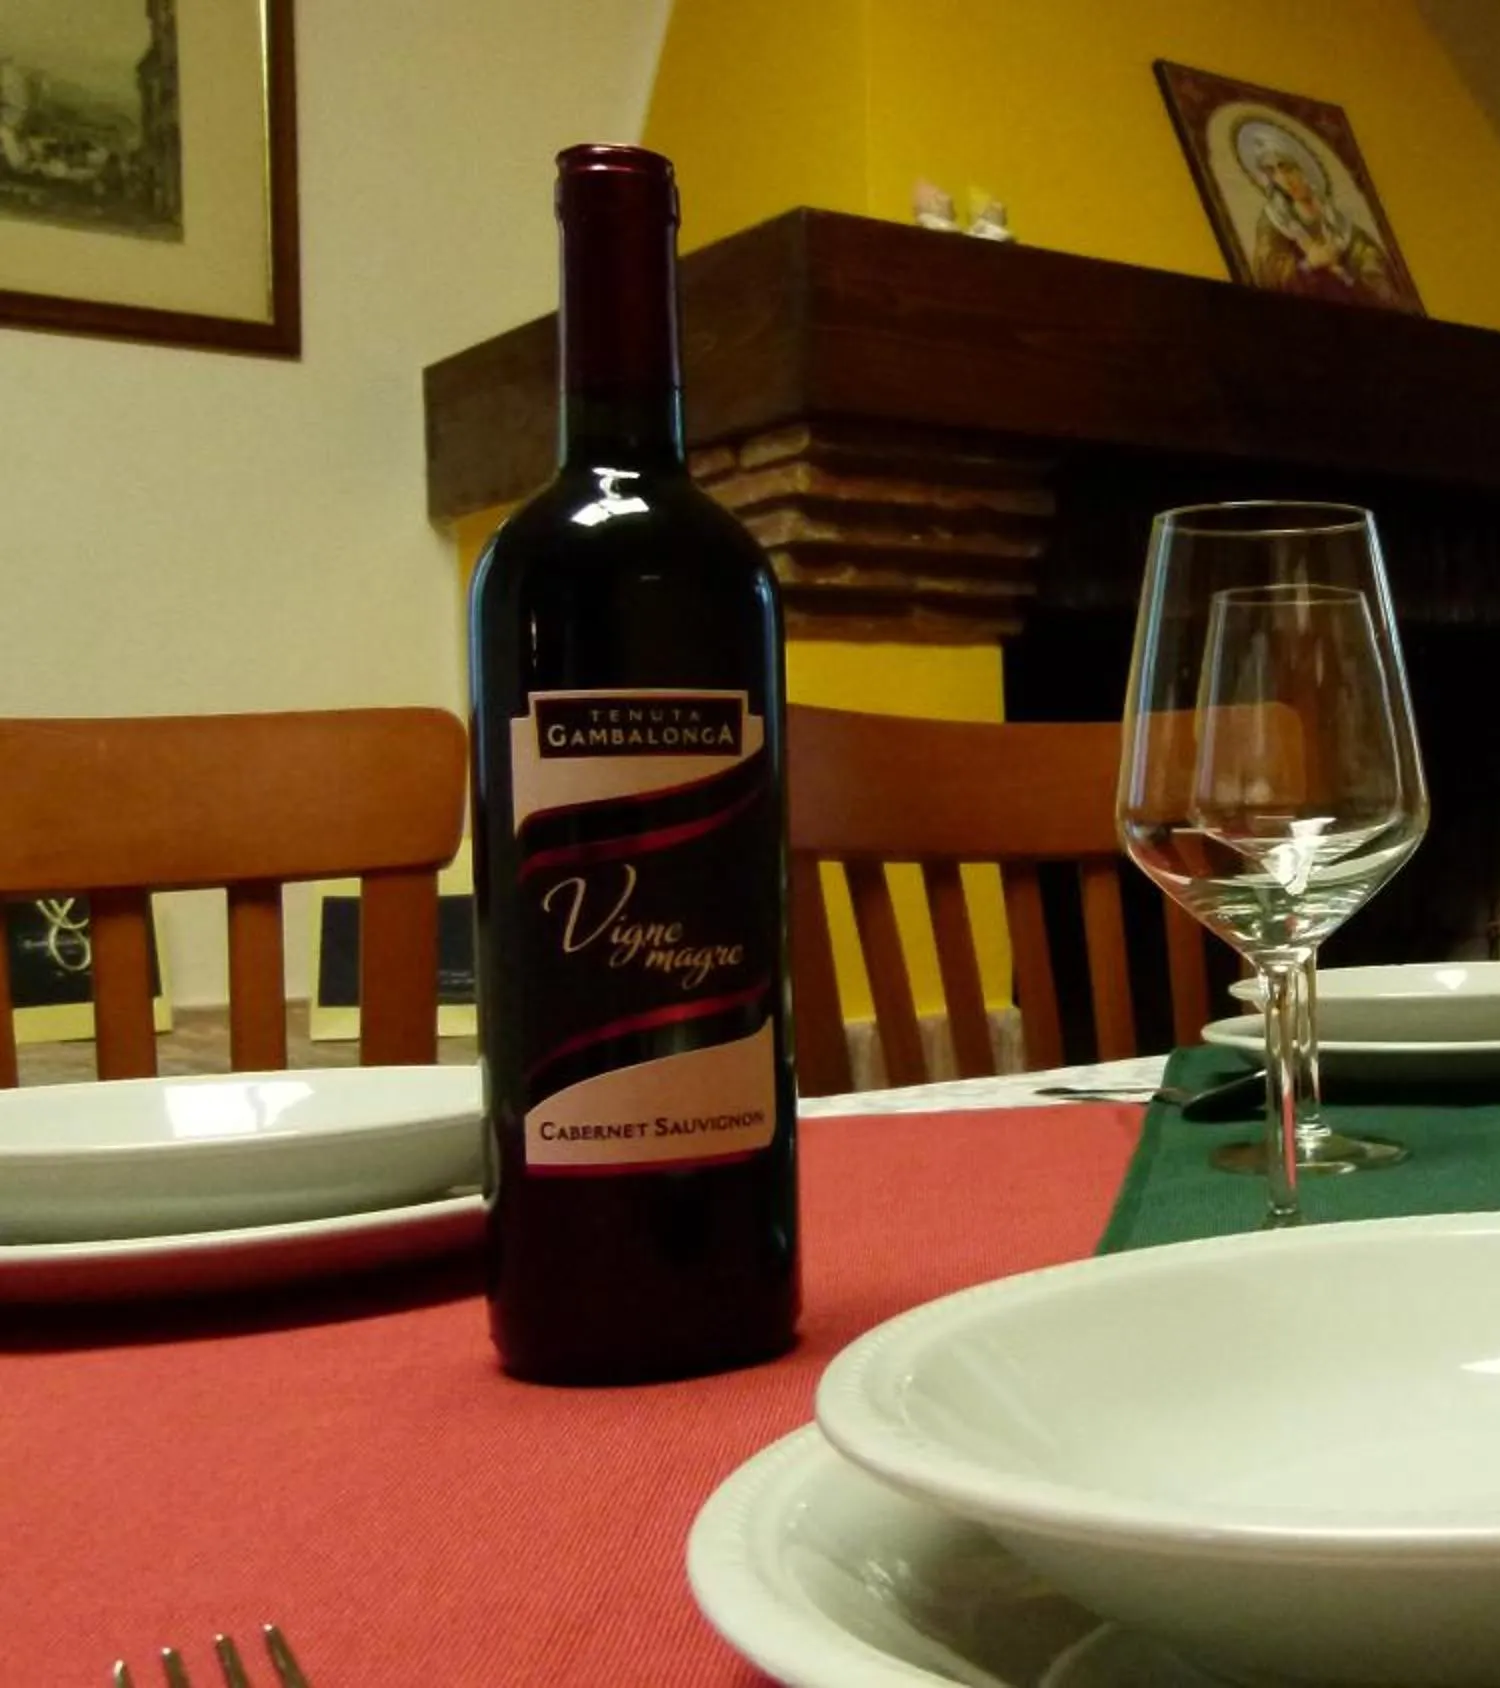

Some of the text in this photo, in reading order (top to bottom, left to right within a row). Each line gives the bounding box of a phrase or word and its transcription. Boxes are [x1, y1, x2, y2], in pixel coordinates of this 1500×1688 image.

[591, 709, 701, 723] TENUTA
[547, 722, 734, 748] GAMBALONGA
[541, 863, 683, 969] Vigne
[644, 943, 744, 991] magre
[540, 1110, 765, 1141] CABERNET SAUVIGNON
